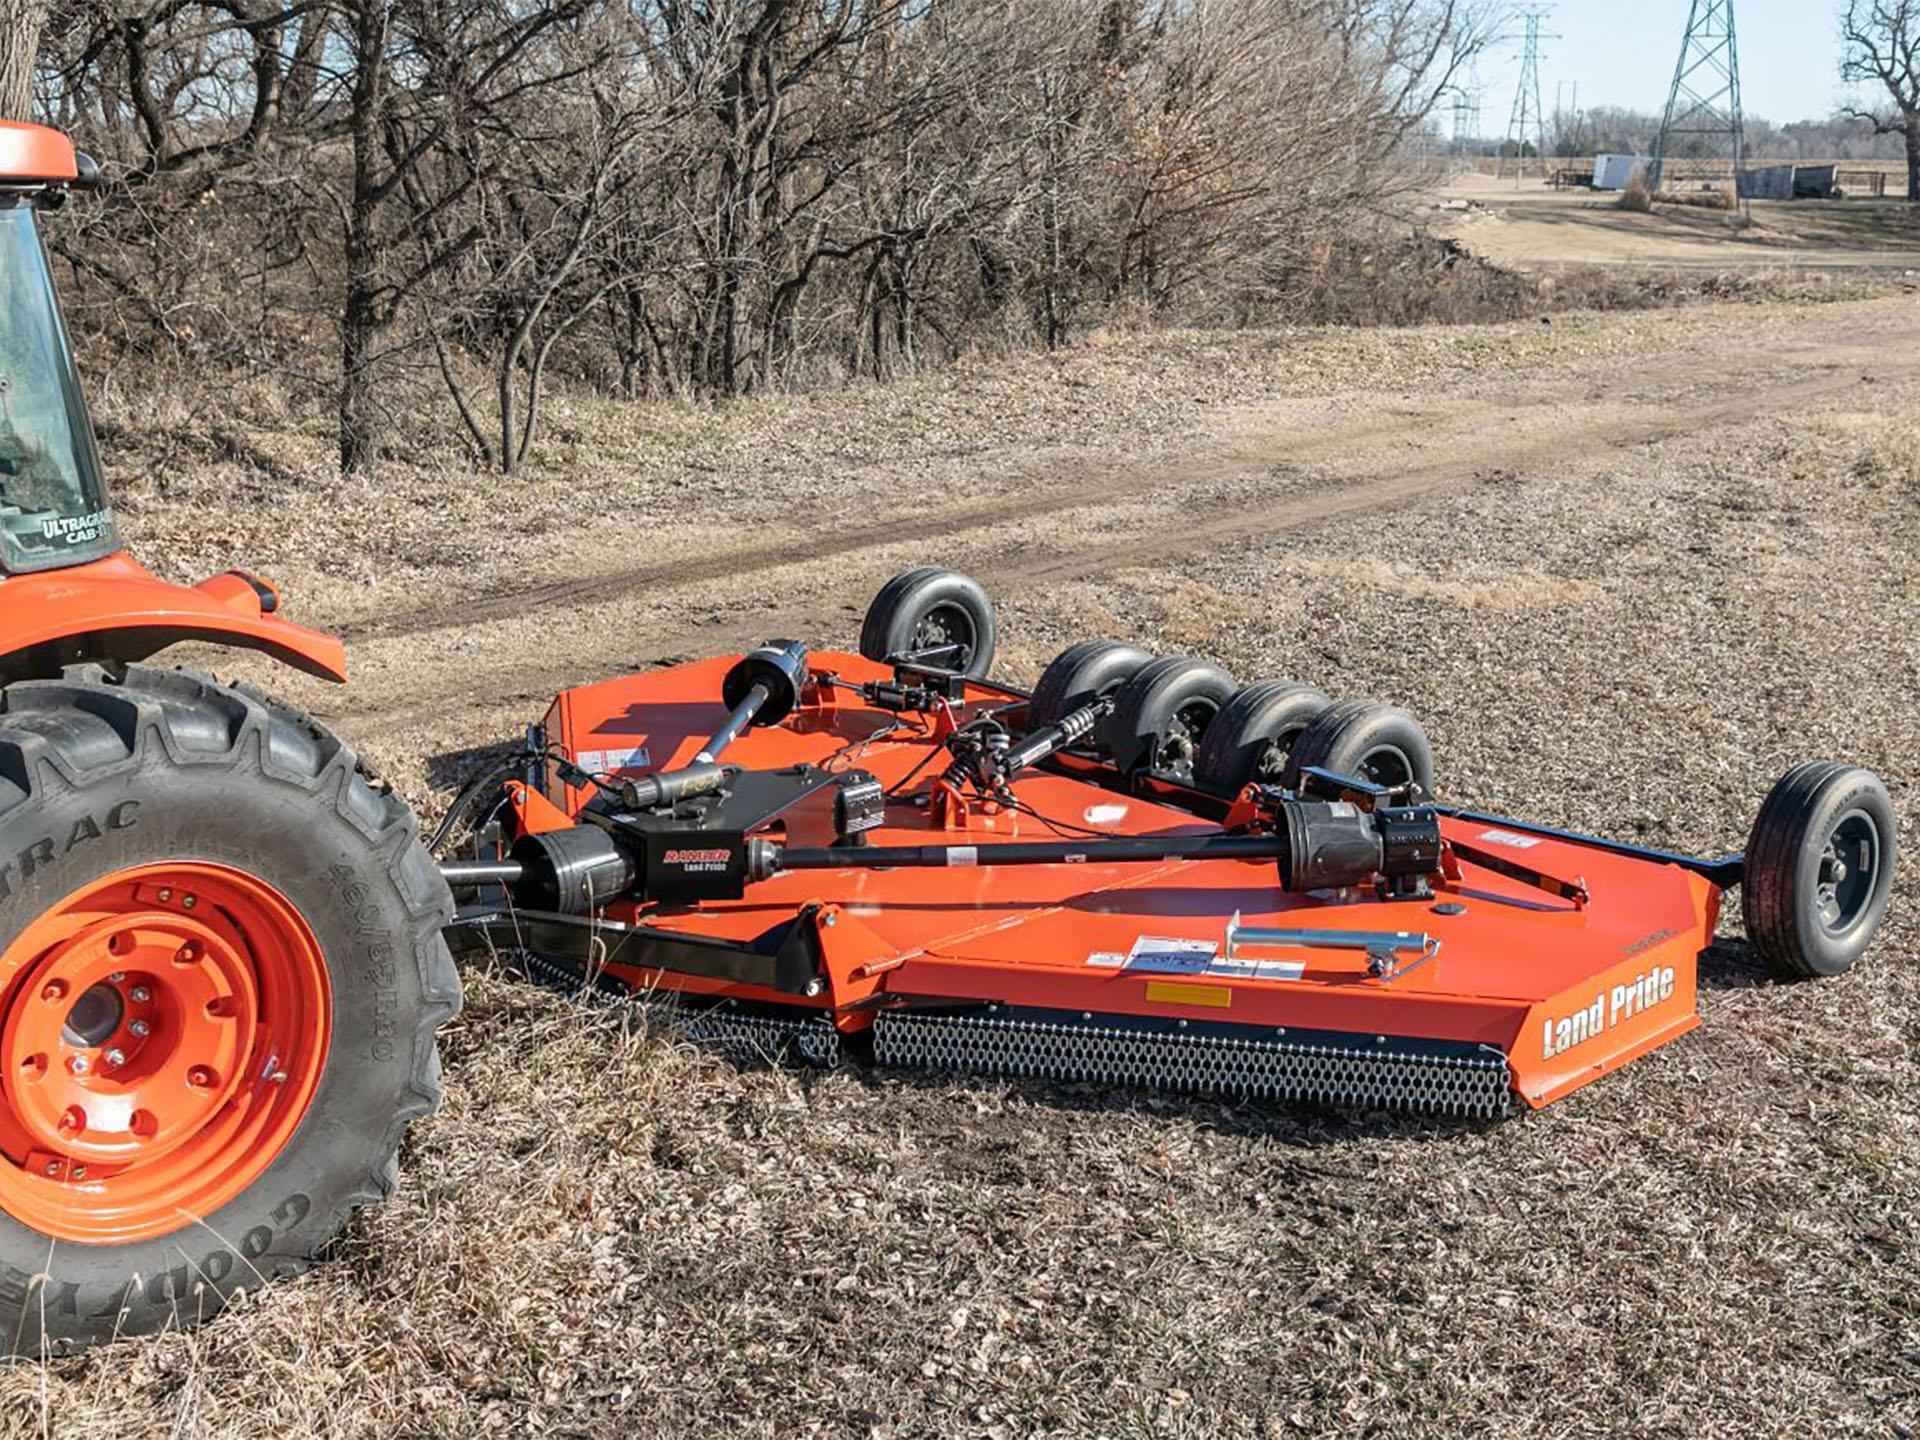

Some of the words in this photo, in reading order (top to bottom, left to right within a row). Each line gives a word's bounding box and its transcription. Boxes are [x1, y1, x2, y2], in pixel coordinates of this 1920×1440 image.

[684, 863, 704, 872] Land
[705, 862, 727, 872] Pride
[1542, 991, 1606, 1061] Land
[1609, 964, 1676, 1029] Pride
